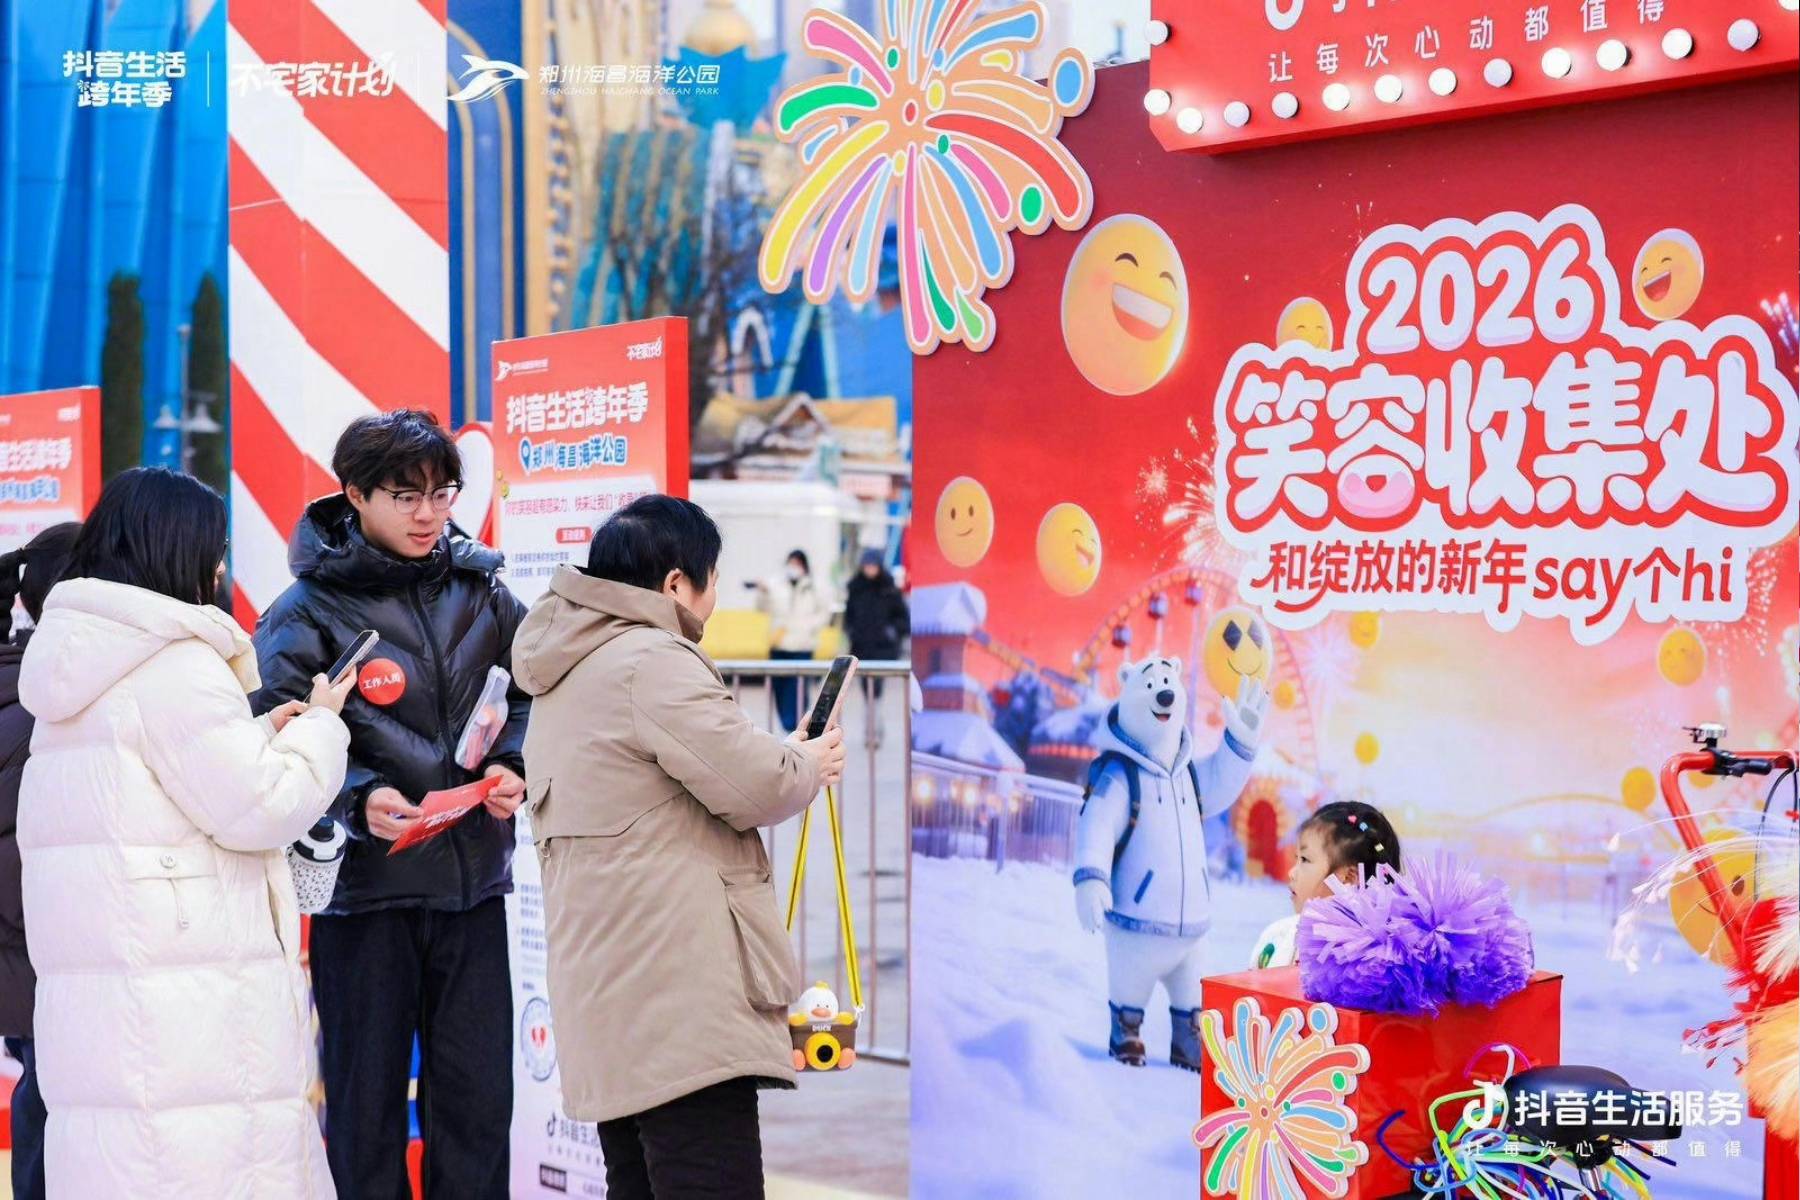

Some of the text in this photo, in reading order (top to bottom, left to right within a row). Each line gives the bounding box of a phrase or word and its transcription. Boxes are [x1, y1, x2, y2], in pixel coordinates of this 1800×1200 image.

[1366, 236, 1596, 355] 2026
[506, 381, 649, 435] 抖音生活跨年季
[531, 434, 628, 468] 郑州海昌海洋公园
[1234, 347, 1777, 520] 笑容收集处
[1251, 537, 1733, 628] 和绽放的新年say个hi
